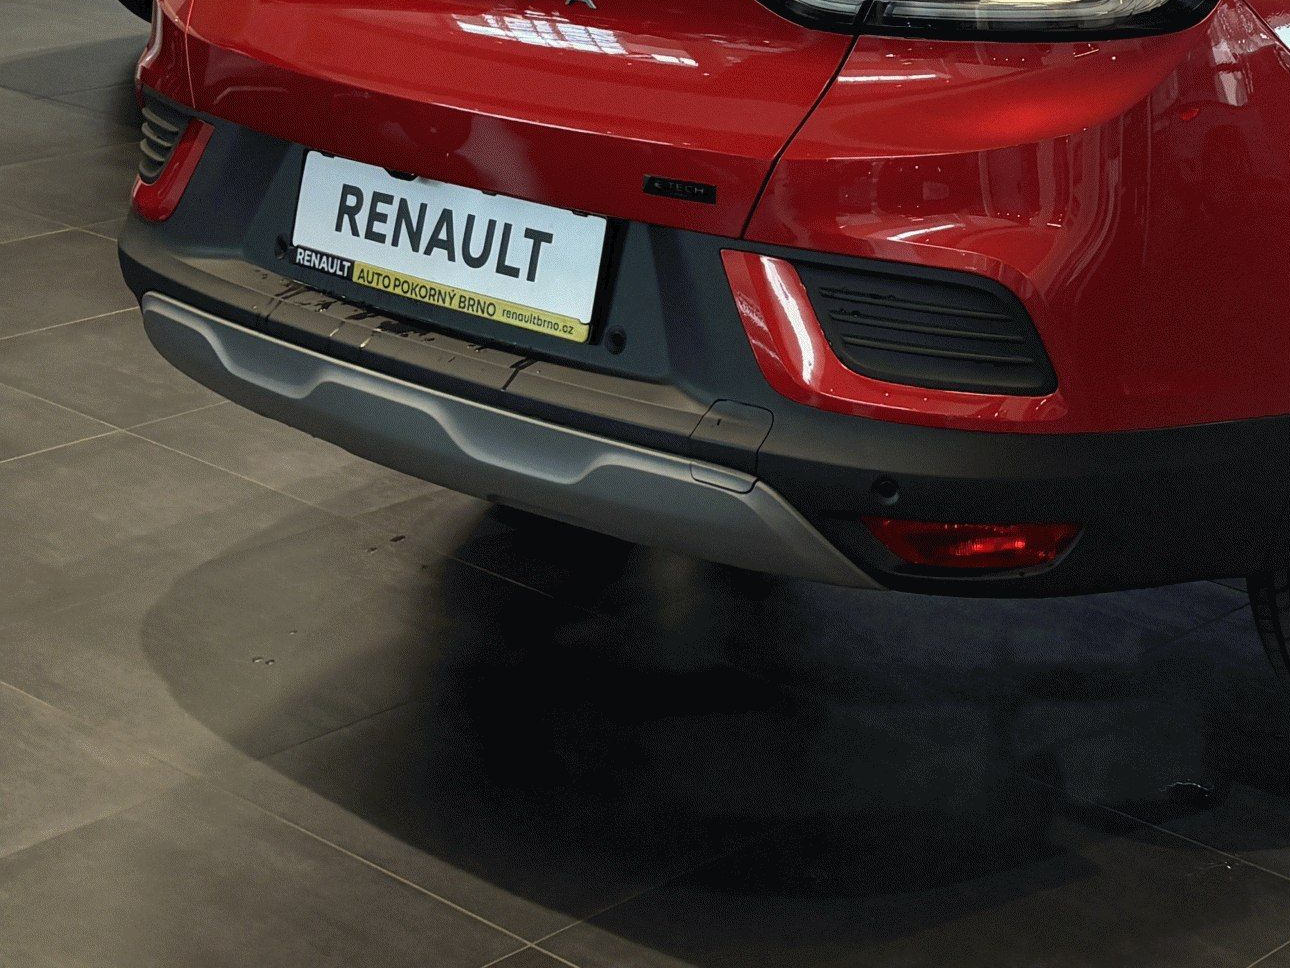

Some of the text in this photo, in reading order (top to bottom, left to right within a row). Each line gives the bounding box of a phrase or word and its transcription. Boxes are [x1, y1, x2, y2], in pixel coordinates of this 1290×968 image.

[296, 248, 351, 278] RENAULT
[335, 184, 553, 282] RENAULT
[357, 268, 574, 335] AUTO POKORNÝ BRNO renaultbrno.cz
